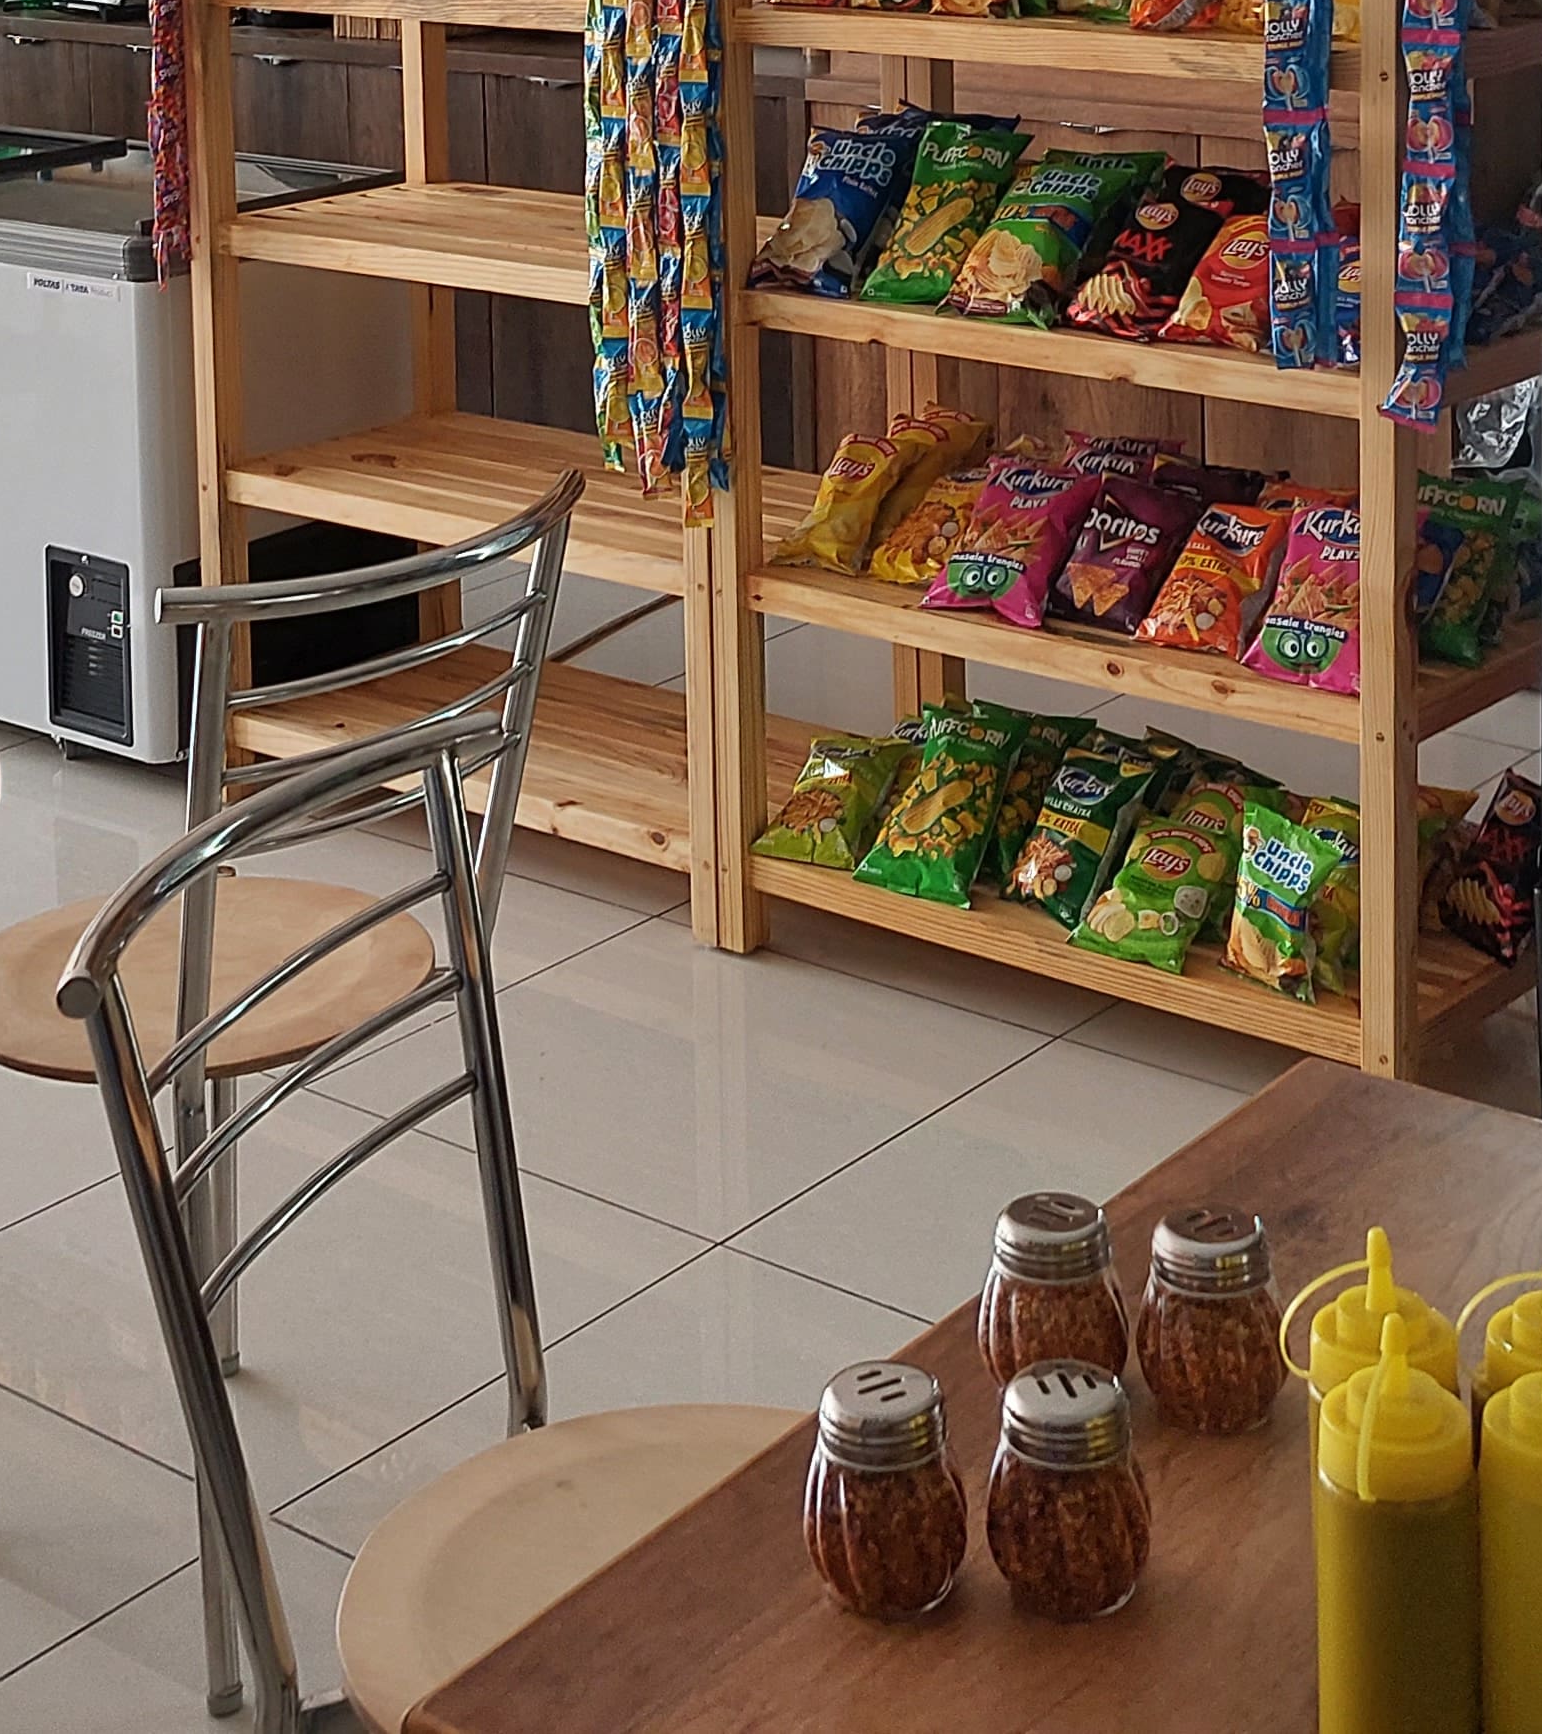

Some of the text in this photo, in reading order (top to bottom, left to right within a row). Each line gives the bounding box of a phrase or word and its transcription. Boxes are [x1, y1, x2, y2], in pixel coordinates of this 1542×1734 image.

[831, 139, 897, 167] Uncle
[819, 154, 893, 187] Chipps
[1042, 168, 1102, 189] Uncle
[1030, 178, 1098, 200] Chipps
[1182, 176, 1220, 197] Lay's
[1138, 203, 1178, 225] Lay's
[1222, 237, 1271, 261] Lay's
[33, 277, 61, 290] VOLTAS
[831, 458, 875, 480] Lay's
[994, 466, 1077, 493] Kurkure
[1084, 508, 1160, 545] Doritos
[1302, 510, 1361, 539] Kurku
[1200, 557, 1232, 574] EXTRA
[889, 721, 932, 742] Kurk
[1144, 847, 1192, 873] Lay's
[1266, 838, 1315, 877] Uncle
[1252, 850, 1311, 894] Chipps
